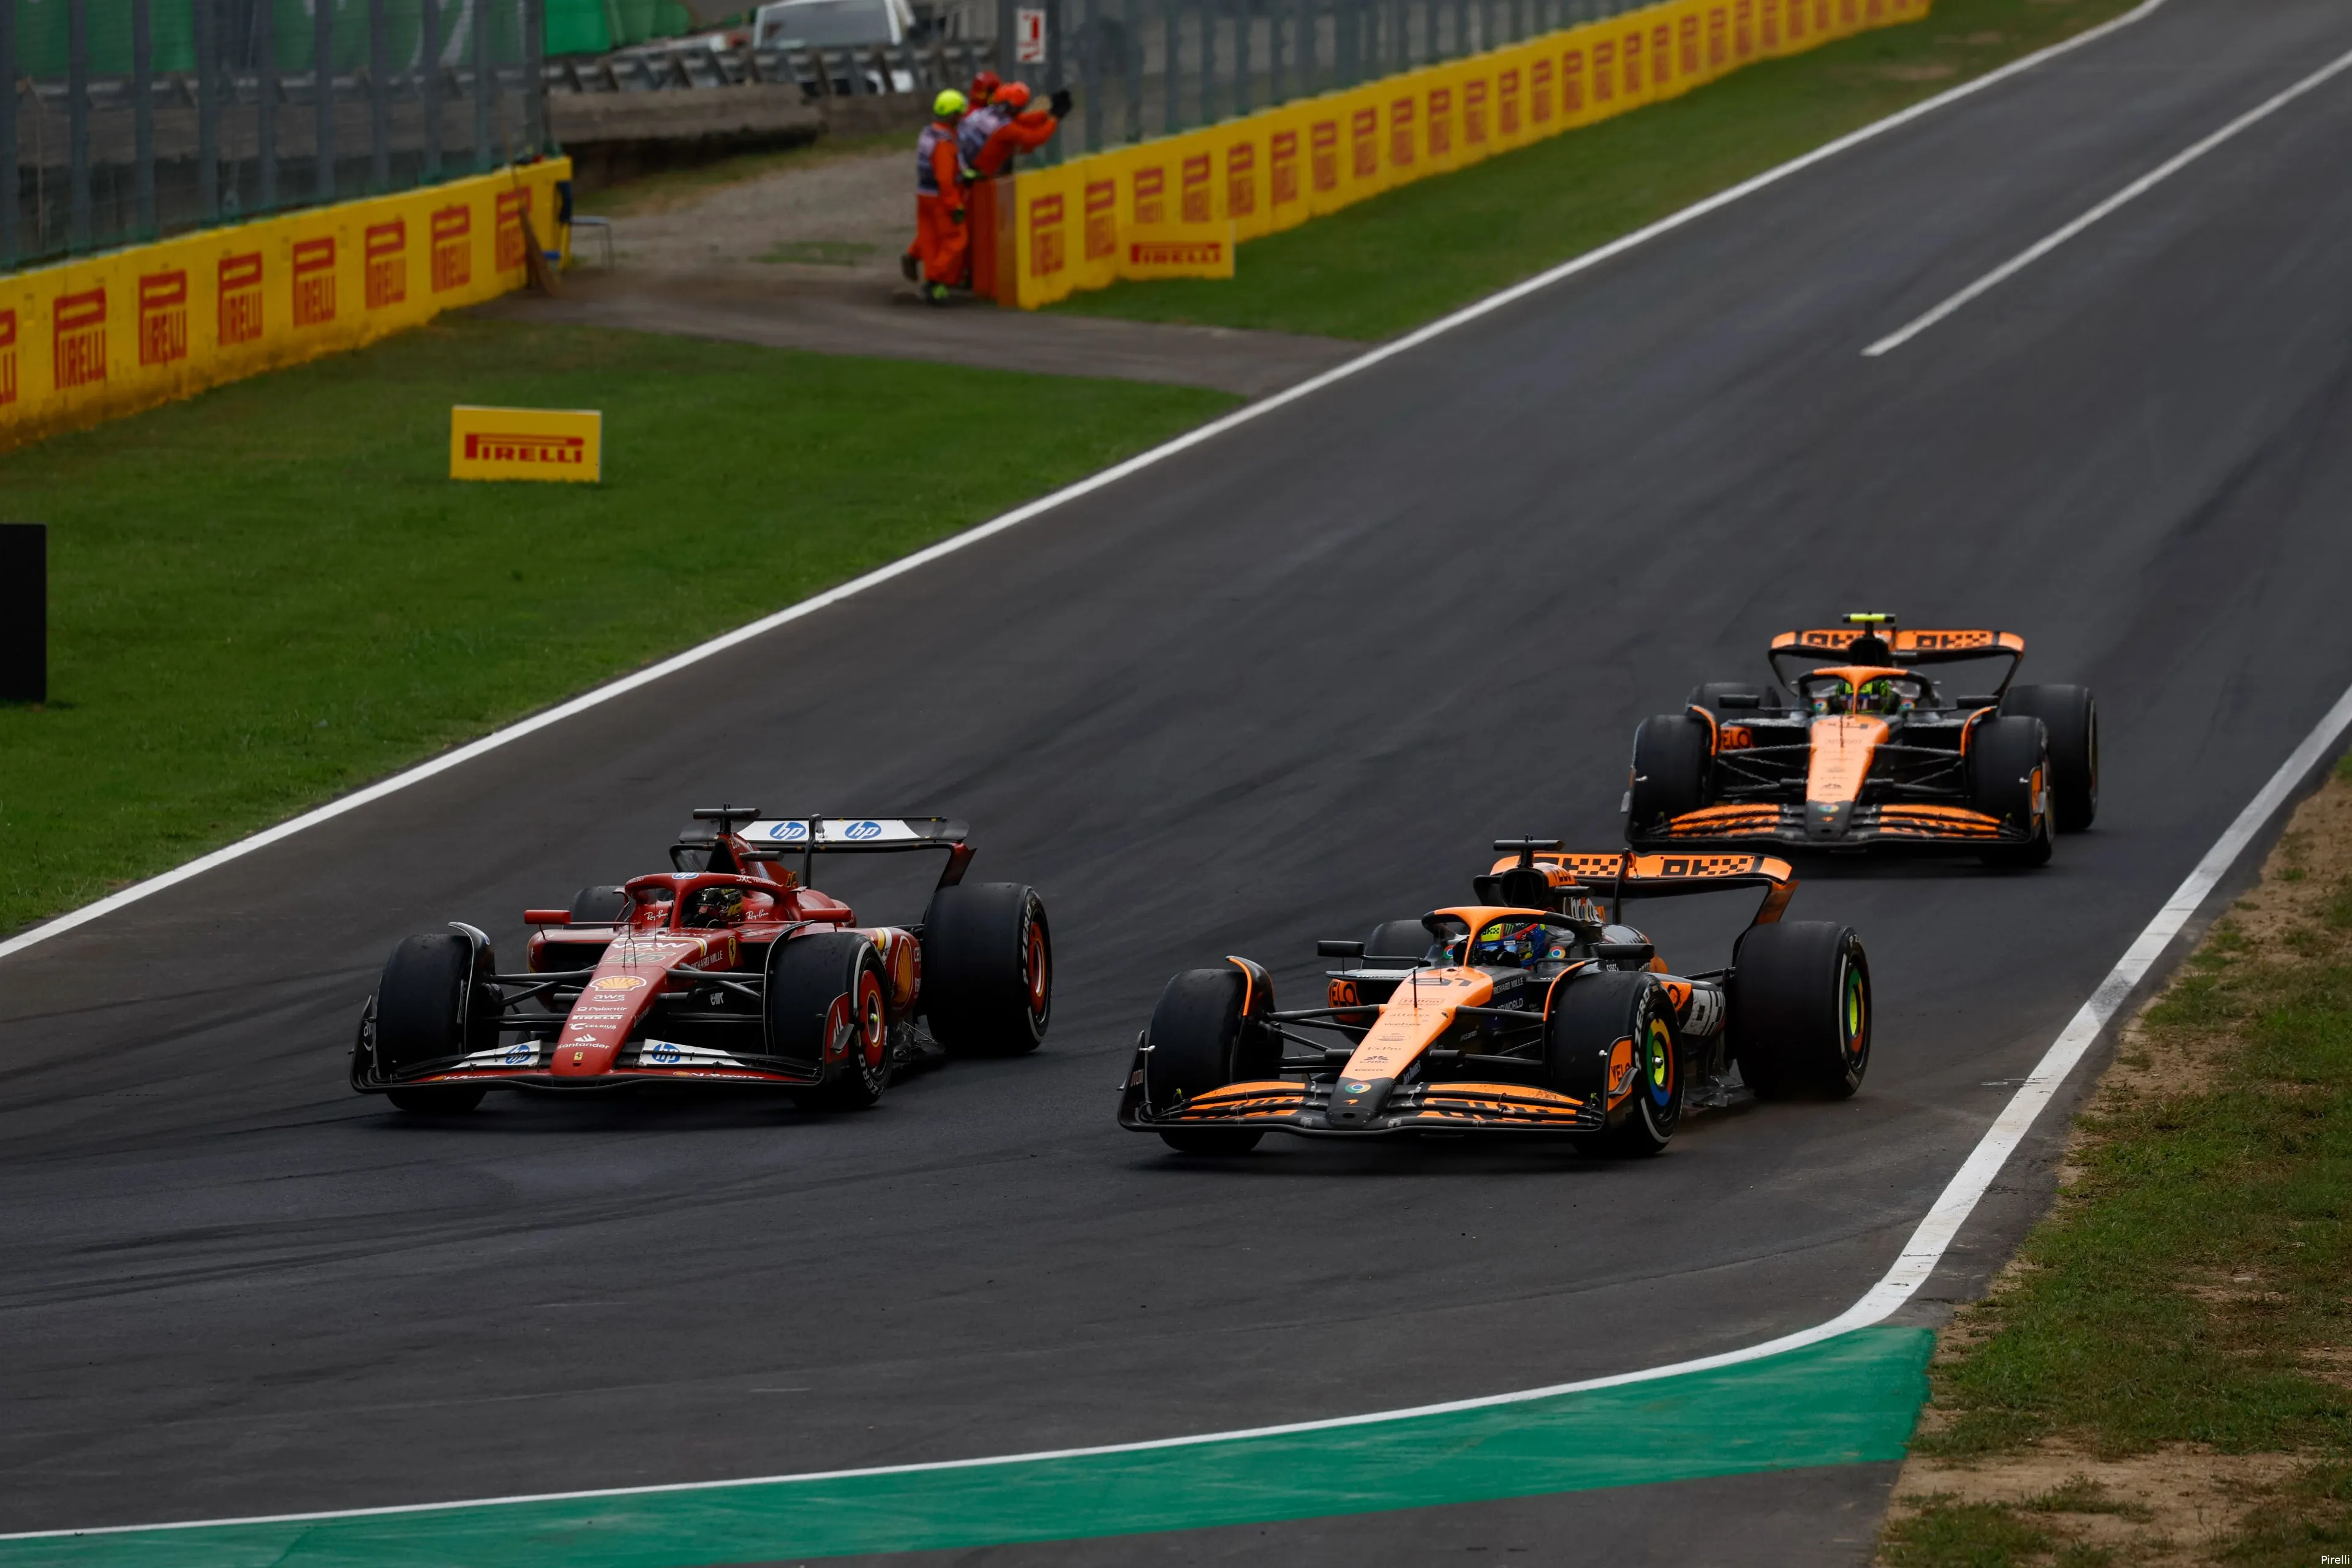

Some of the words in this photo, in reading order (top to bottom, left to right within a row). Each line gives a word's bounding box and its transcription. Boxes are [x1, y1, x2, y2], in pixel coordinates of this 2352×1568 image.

[140, 270, 187, 367] PIRELLI
[53, 287, 106, 391] PIRELLI
[466, 432, 584, 462] PIRELLI
[772, 822, 803, 840] hp
[848, 821, 878, 840] hp
[1660, 858, 1747, 876] OKX
[644, 910, 669, 921] Ray-Ban
[745, 909, 769, 920] Ray-Ban
[1022, 903, 1031, 964] ZERO
[691, 956, 709, 970] RICHARD
[710, 950, 723, 965] MILLE
[1493, 981, 1510, 995] RICHARD
[1510, 978, 1524, 988] MILLE
[1504, 998, 1523, 1011] WORLD
[1635, 987, 1650, 1048] ZERO
[858, 1054, 879, 1095] ZERO
